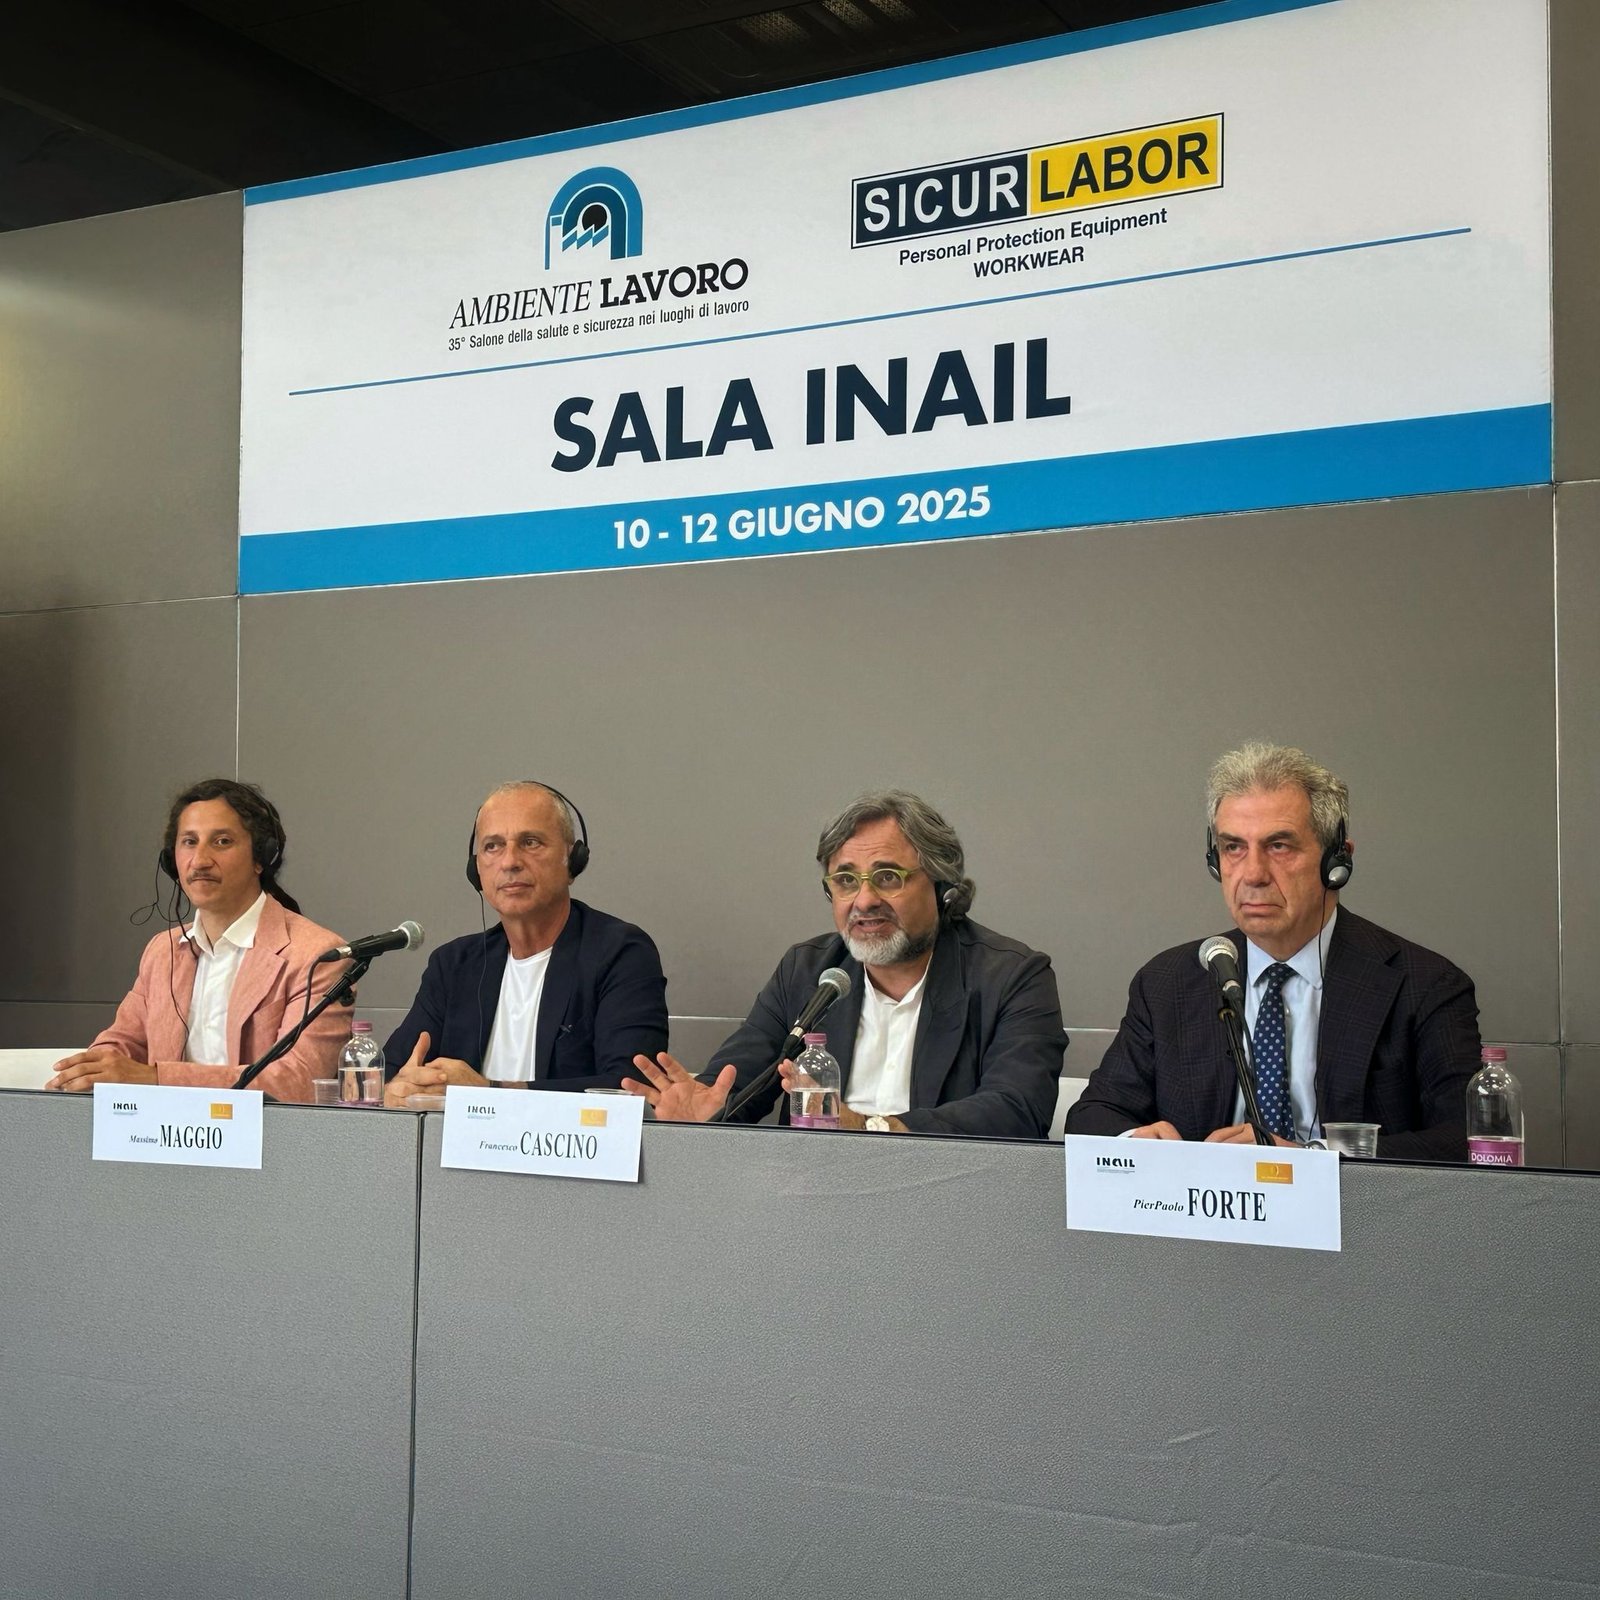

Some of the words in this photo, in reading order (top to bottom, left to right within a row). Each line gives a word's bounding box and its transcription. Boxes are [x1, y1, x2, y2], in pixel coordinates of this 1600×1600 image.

[899, 239, 971, 265] Personal
[976, 227, 1065, 254] Protection
[1071, 208, 1167, 239] Equipment
[973, 246, 1085, 278] WORKWEAR
[449, 281, 592, 329] AMBIENTE
[600, 258, 749, 308] LAVORO
[448, 336, 466, 351] 35°
[469, 333, 504, 349] Salone
[508, 328, 533, 344] della
[536, 322, 569, 340] salute
[573, 322, 580, 335] e
[583, 314, 634, 333] sicurezza
[638, 311, 656, 326] nei
[660, 304, 695, 326] luoghi
[699, 302, 710, 318] di
[714, 299, 749, 316] lavoro
[551, 377, 773, 472] SALA
[806, 337, 1071, 445] INAIL
[613, 518, 650, 549] 10
[681, 513, 718, 544] 12
[728, 495, 885, 539] GIUGNO
[896, 485, 991, 525] 2025
[129, 1135, 158, 1144] Massimo
[160, 1124, 223, 1149] MAGGIO
[479, 1140, 518, 1151] Francesco
[520, 1131, 598, 1159] CASCINO
[1471, 1152, 1513, 1163] DOLOMIA
[1133, 1199, 1184, 1212] PierPaolo
[1188, 1188, 1266, 1222] FORTE
